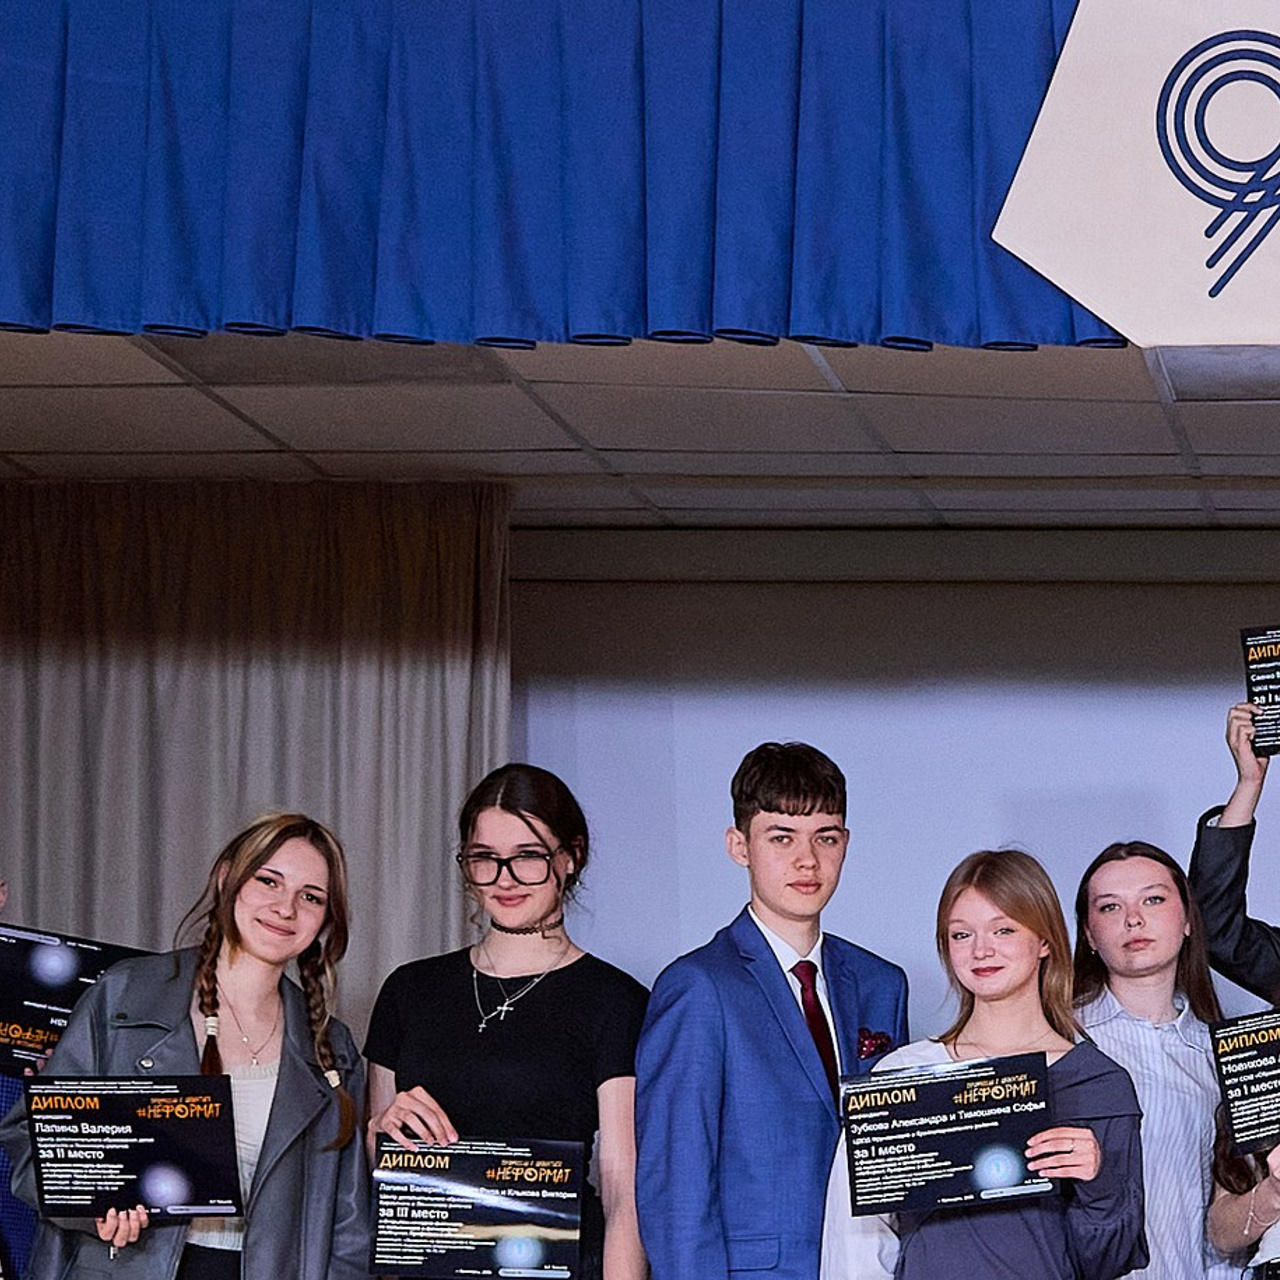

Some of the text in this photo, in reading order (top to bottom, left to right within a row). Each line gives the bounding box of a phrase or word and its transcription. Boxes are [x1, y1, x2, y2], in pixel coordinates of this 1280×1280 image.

[1222, 1056, 1276, 1074] Новикова
[847, 1088, 917, 1112] ДИПЛОМ
[952, 1080, 1038, 1105] #НЕФОРМАТ
[1227, 1088, 1242, 1100] за
[31, 1096, 100, 1111] ДИПЛОМ
[136, 1103, 222, 1119] #НЕФОРМАТ
[850, 1123, 890, 1135] Зубкова
[1012, 1101, 1046, 1113] Софья
[35, 1123, 133, 1135] Лапина Валерия
[39, 1149, 105, 1159] за II место
[854, 1149, 868, 1159] за
[878, 1144, 916, 1156] место
[379, 1154, 450, 1169] ДИПЛОМ
[486, 1168, 572, 1184] #НЕФОРМАТ
[379, 1207, 449, 1220] за III место
